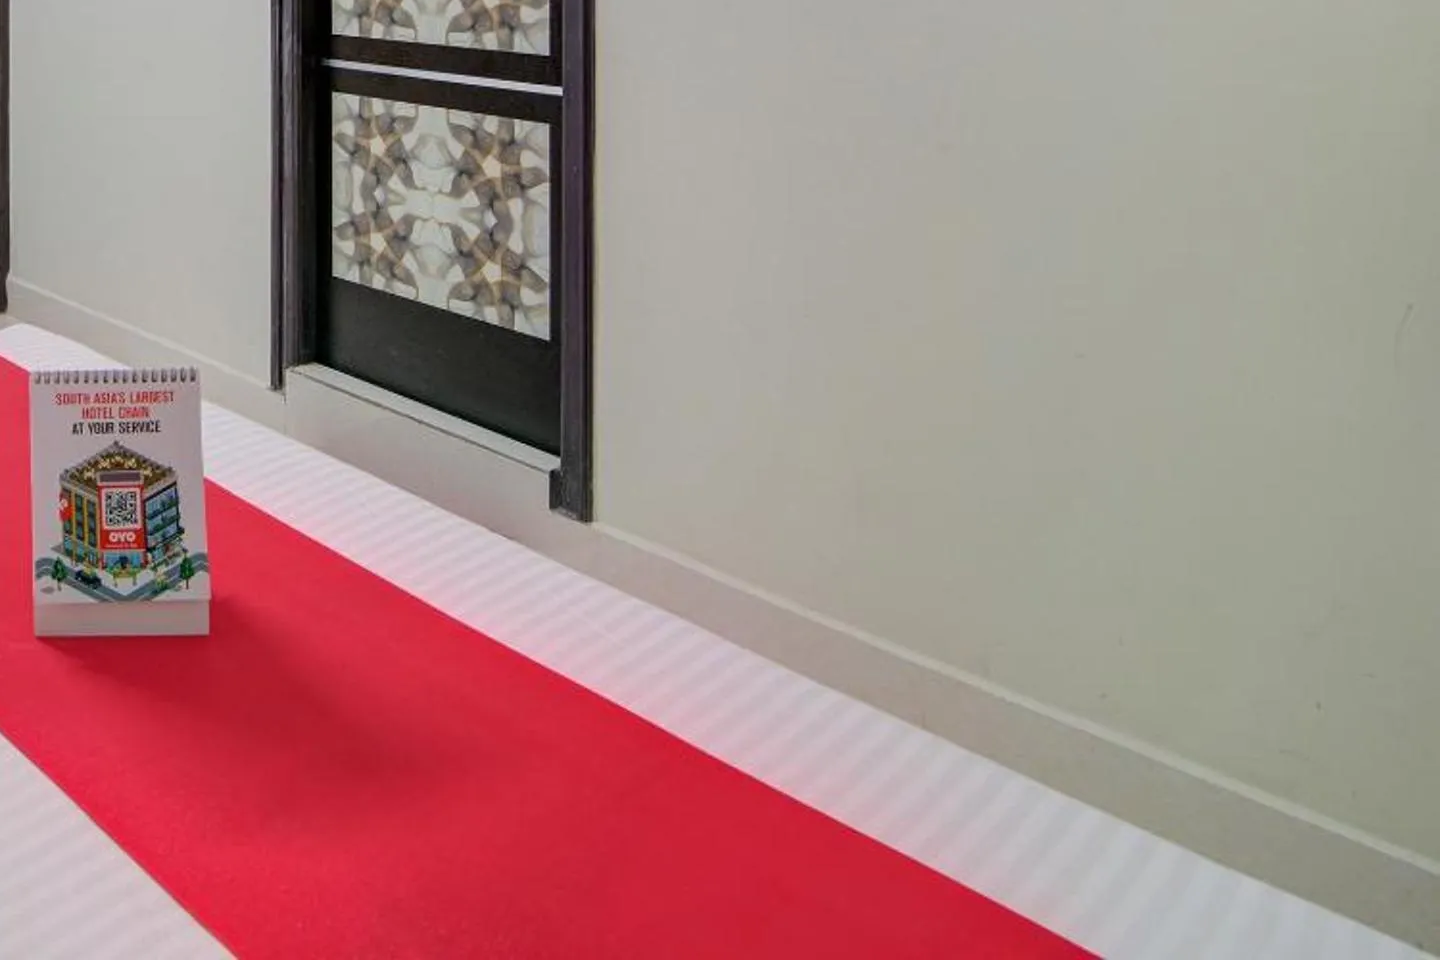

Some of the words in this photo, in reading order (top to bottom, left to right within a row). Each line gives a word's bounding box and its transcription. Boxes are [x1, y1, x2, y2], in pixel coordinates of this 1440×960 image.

[55, 392, 91, 406] SOUTH
[130, 390, 175, 404] LARGEST
[81, 406, 114, 420] HOTEL
[118, 406, 150, 419] CHAIN
[72, 421, 85, 435] AT
[87, 421, 115, 435] YOUR
[118, 420, 161, 434] SERVICE
[108, 531, 136, 543] OYO
